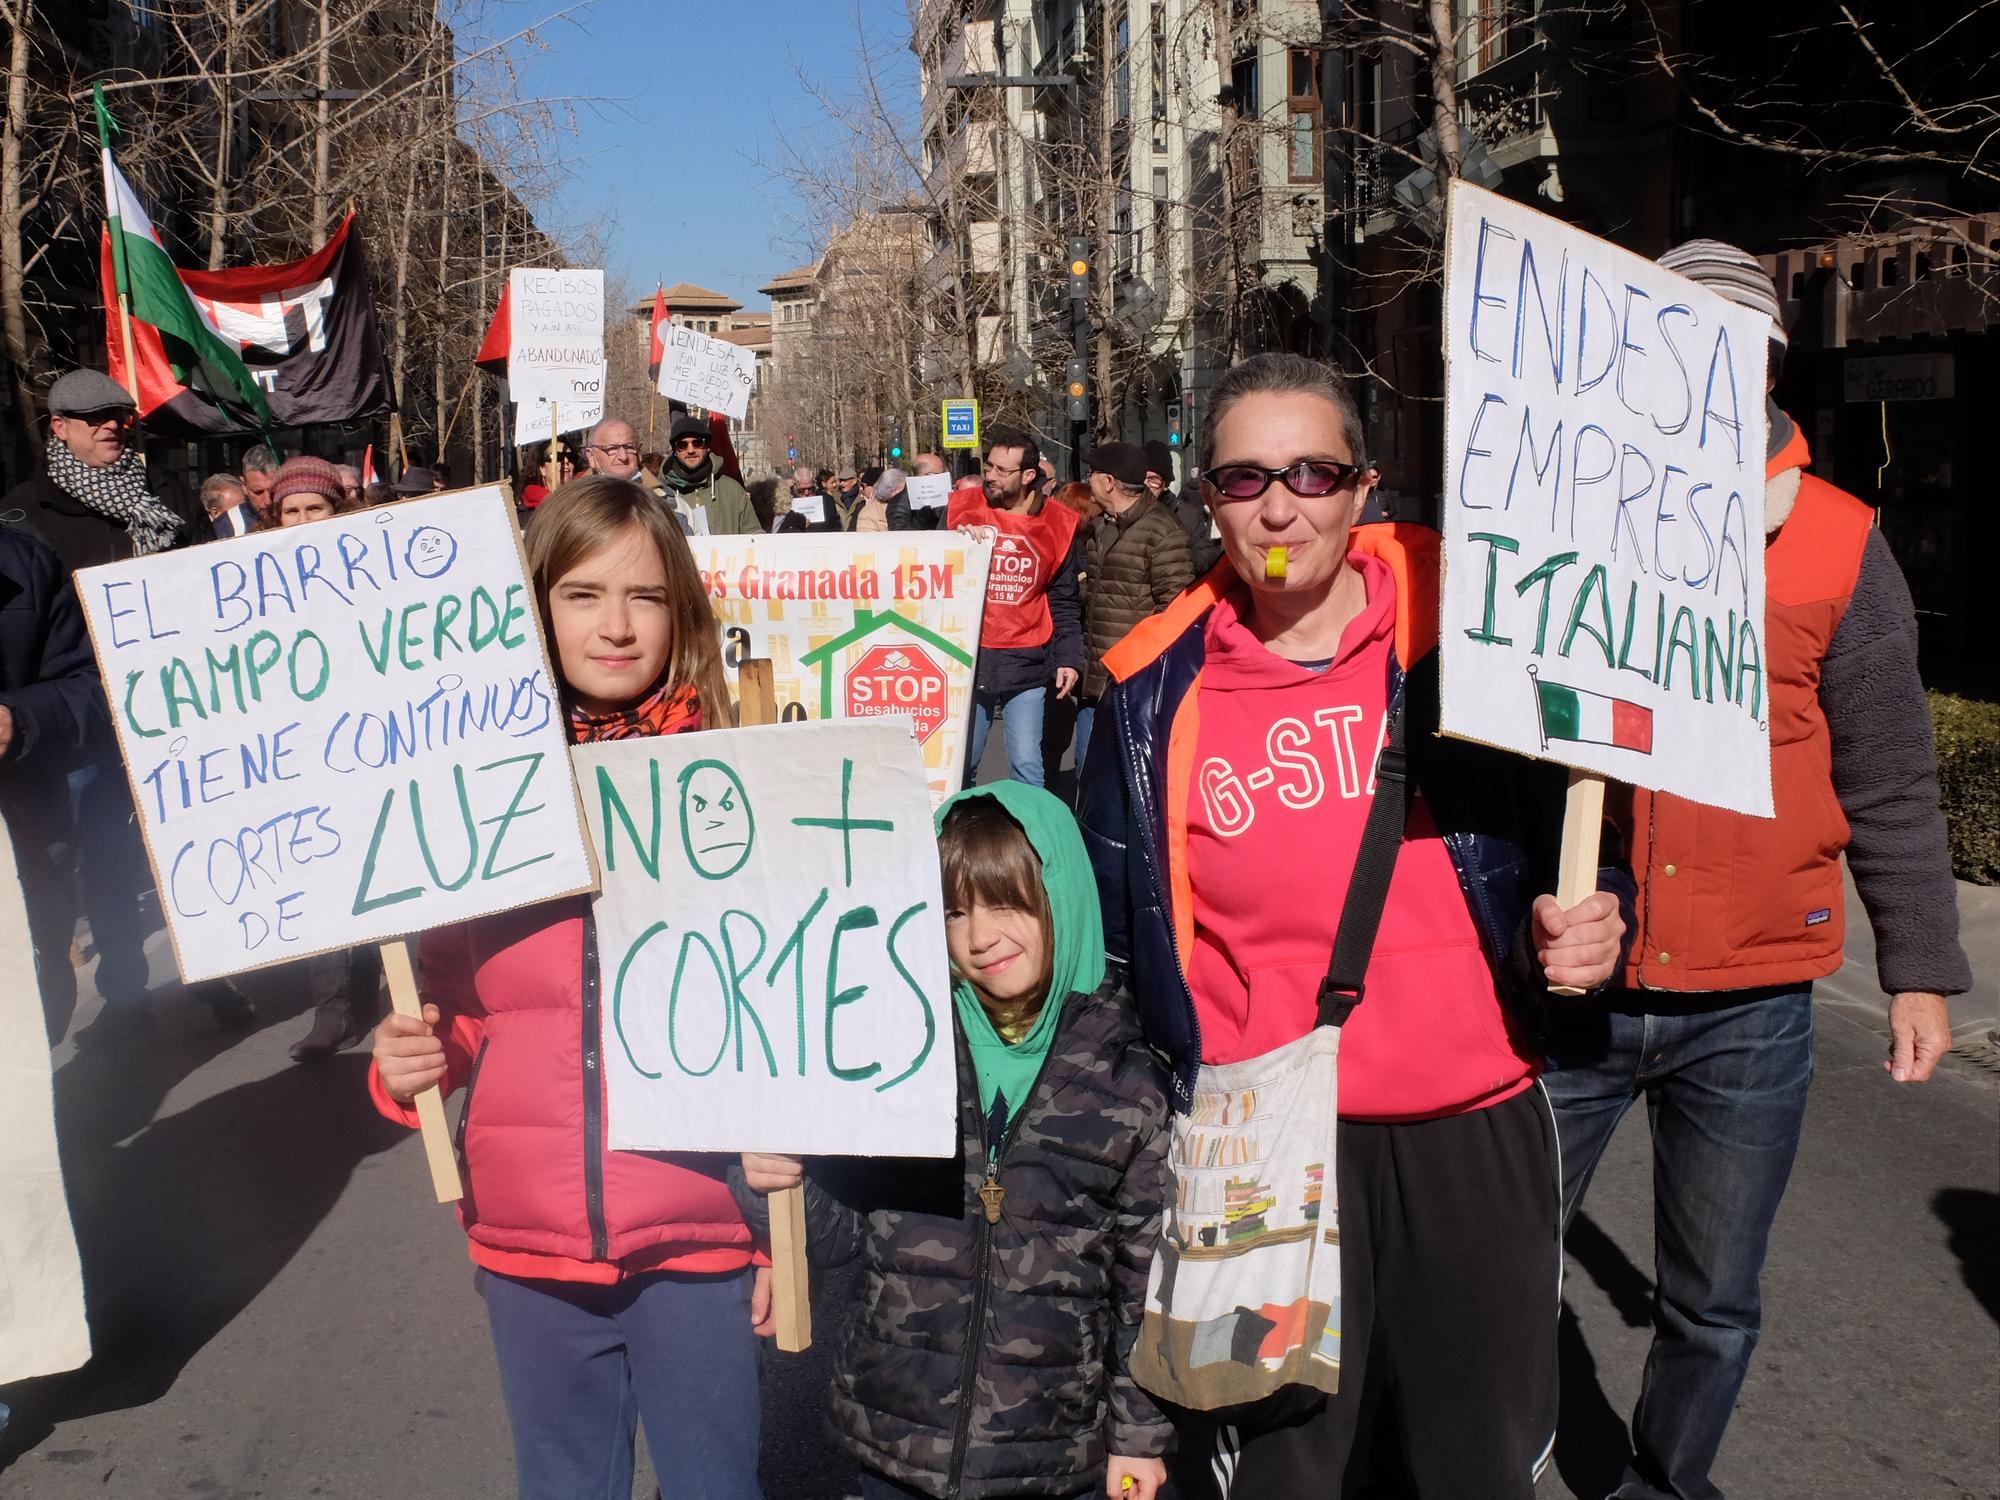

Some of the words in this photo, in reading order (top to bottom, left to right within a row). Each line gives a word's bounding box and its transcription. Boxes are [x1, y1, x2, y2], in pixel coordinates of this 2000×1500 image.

[523, 276, 599, 295] RECIBOS
[199, 277, 334, 360] NT
[520, 299, 598, 321] PAGADOS
[531, 323, 539, 332] Y
[516, 347, 601, 366] ABANDONADOS
[1469, 217, 1743, 471] ENDESA
[673, 366, 690, 377] ME
[697, 372, 730, 390] QUEDO
[710, 362, 729, 377] LUZ
[1460, 392, 1749, 617] EMPRESA
[994, 555, 1033, 573] TOP
[102, 579, 181, 649] EL
[209, 511, 458, 633] BARRIO
[738, 564, 880, 601] Granada
[890, 563, 955, 600] 15M
[988, 581, 1024, 593] ranada
[990, 573, 1033, 584] sahucios
[994, 592, 1005, 600] 15
[124, 629, 330, 738] CAMPO
[358, 583, 526, 676] VERDE
[852, 675, 942, 703] STOP
[853, 703, 941, 718] Desahucios
[142, 735, 302, 824] TIENE
[324, 669, 551, 774] CONTINUOS
[594, 757, 756, 883] NO
[170, 805, 341, 917] CORTES
[238, 890, 305, 950] DE
[350, 752, 556, 916] LUZ
[612, 886, 937, 1094] CORTES
